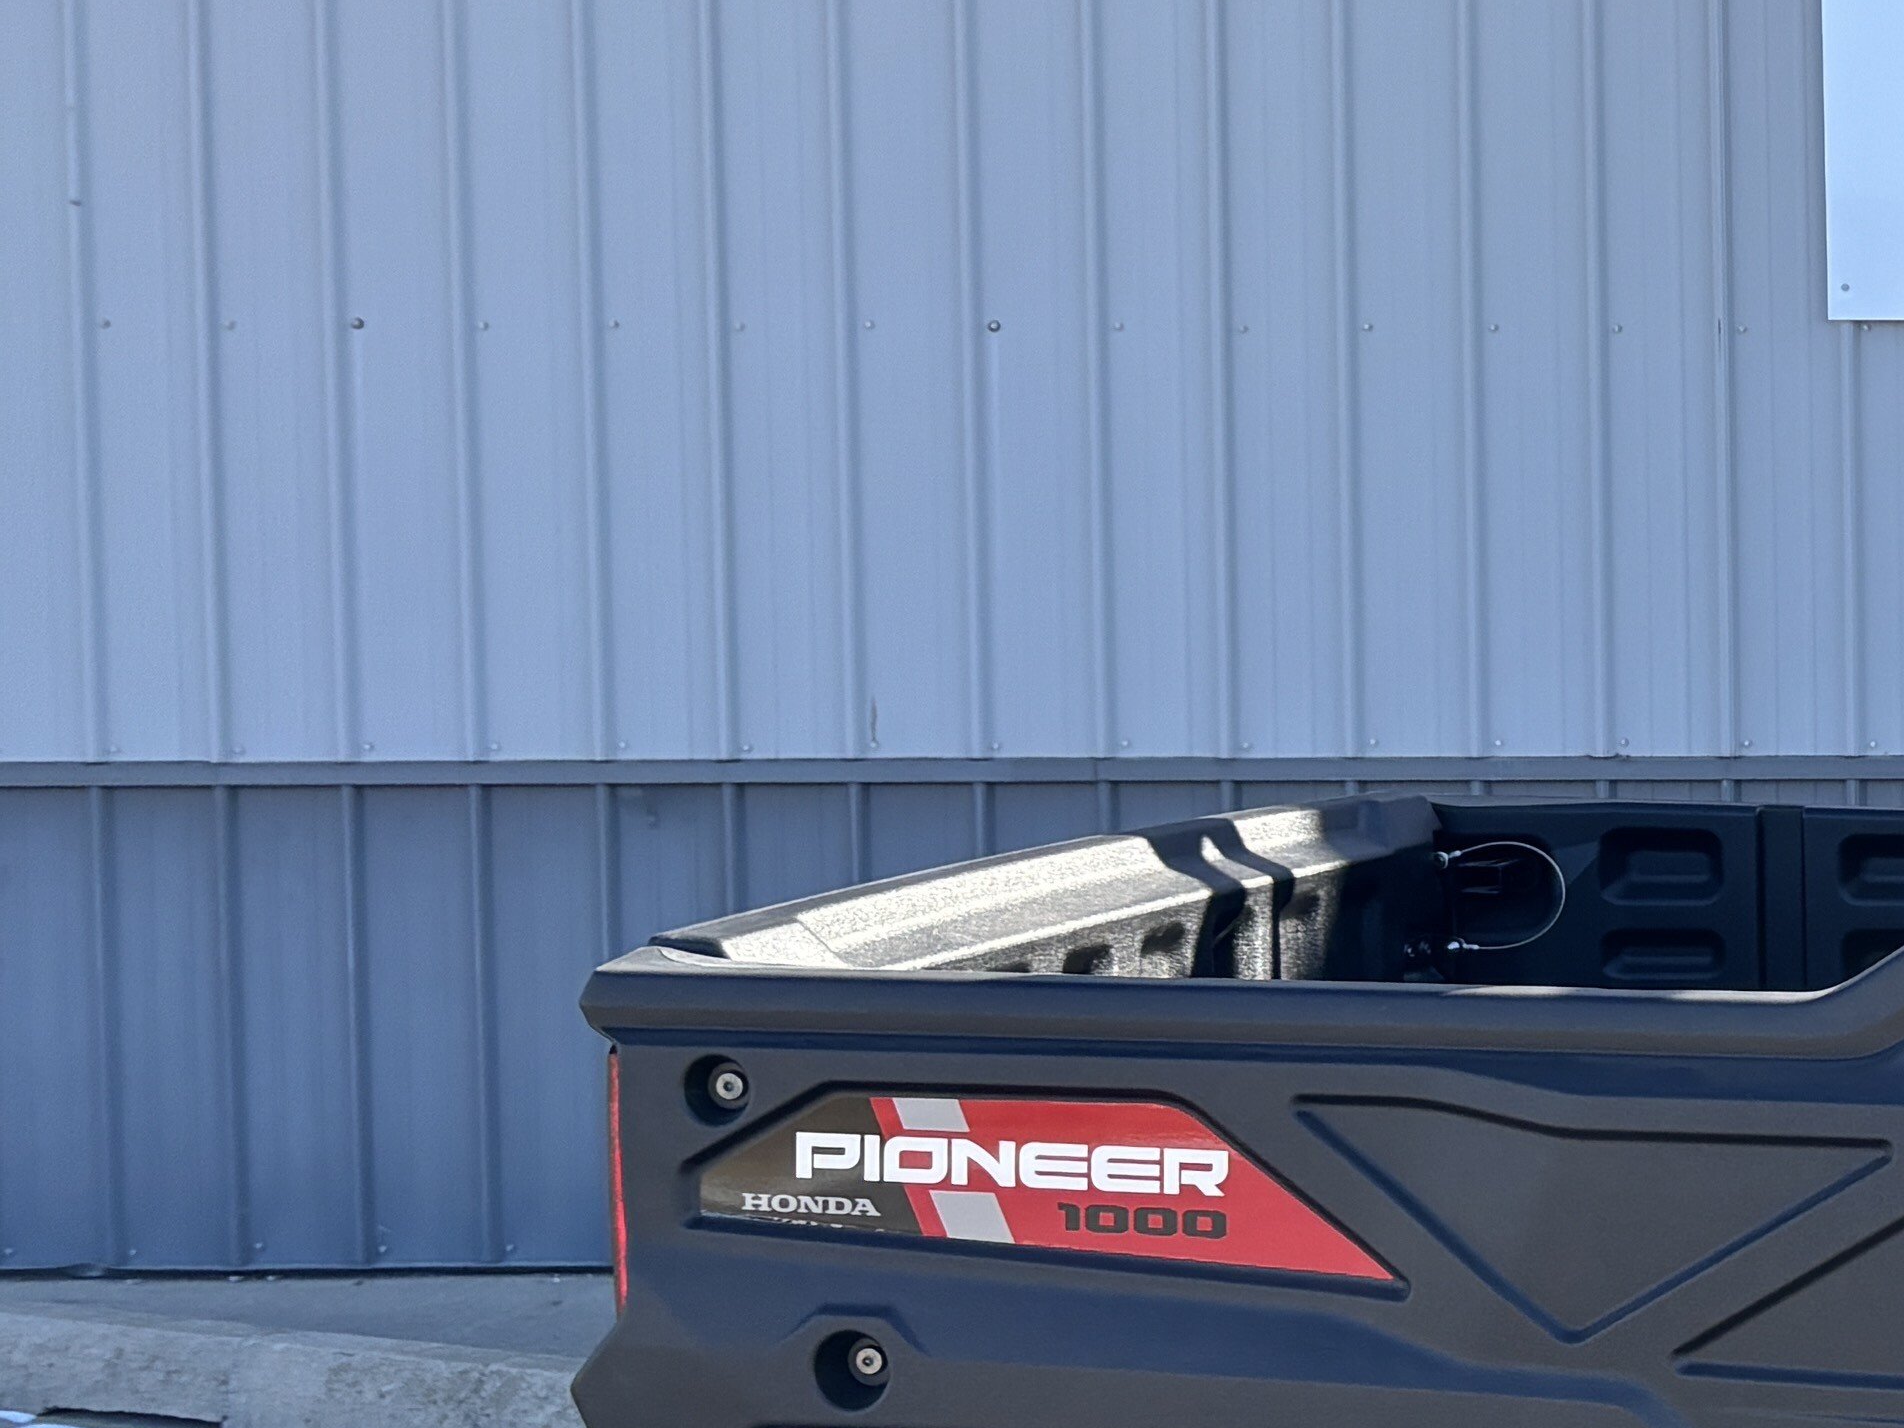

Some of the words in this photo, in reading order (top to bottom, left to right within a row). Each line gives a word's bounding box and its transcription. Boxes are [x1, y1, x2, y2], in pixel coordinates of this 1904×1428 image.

[795, 1131, 1229, 1198] PIONEER
[741, 1192, 882, 1217] HONDA
[1057, 1202, 1228, 1240] 1000
